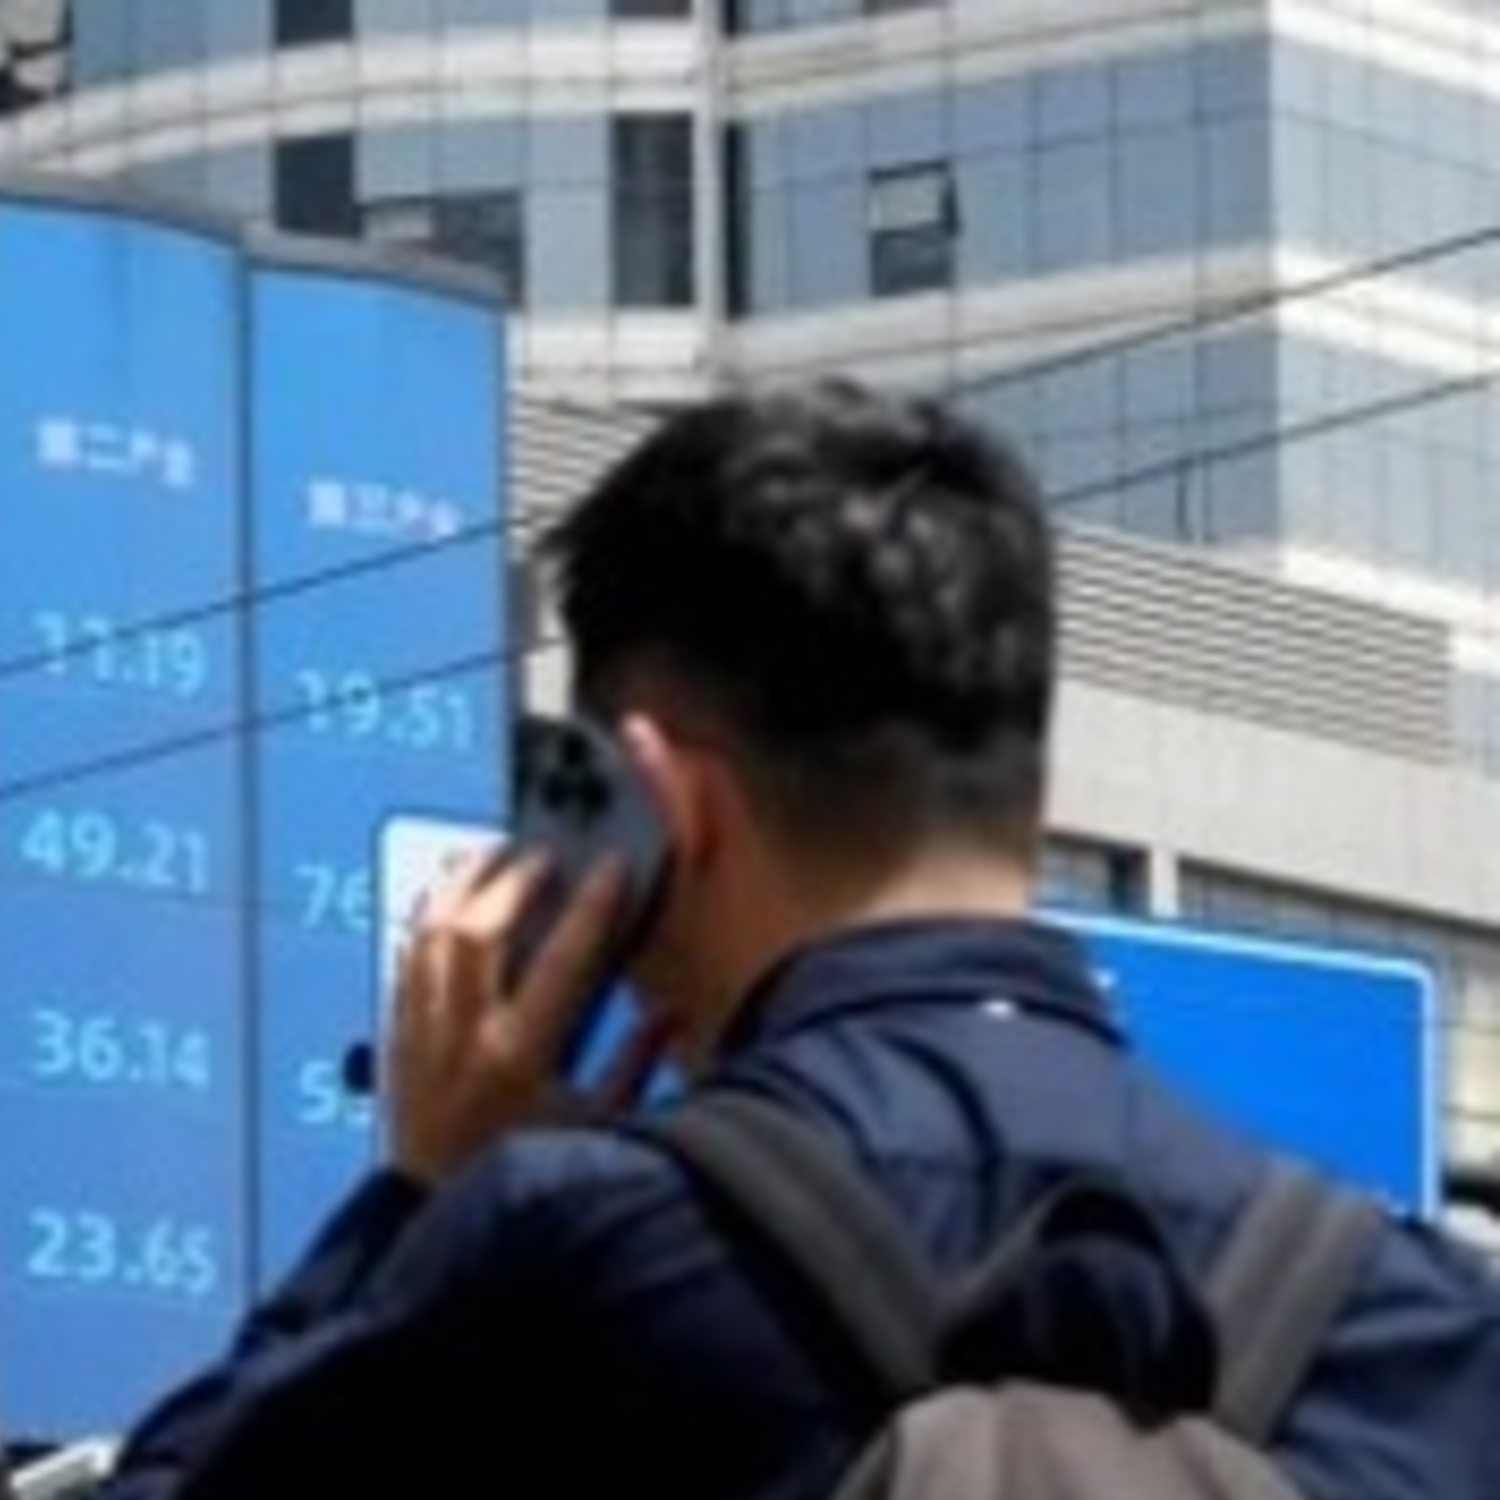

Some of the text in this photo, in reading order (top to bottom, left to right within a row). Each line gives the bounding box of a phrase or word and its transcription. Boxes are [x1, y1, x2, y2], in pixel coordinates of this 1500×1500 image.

[31, 612, 206, 697] 11.19
[296, 670, 475, 750] 19.51
[21, 811, 211, 895] 49.21
[31, 1011, 211, 1088] 36.14
[26, 1211, 217, 1294] 23.65
